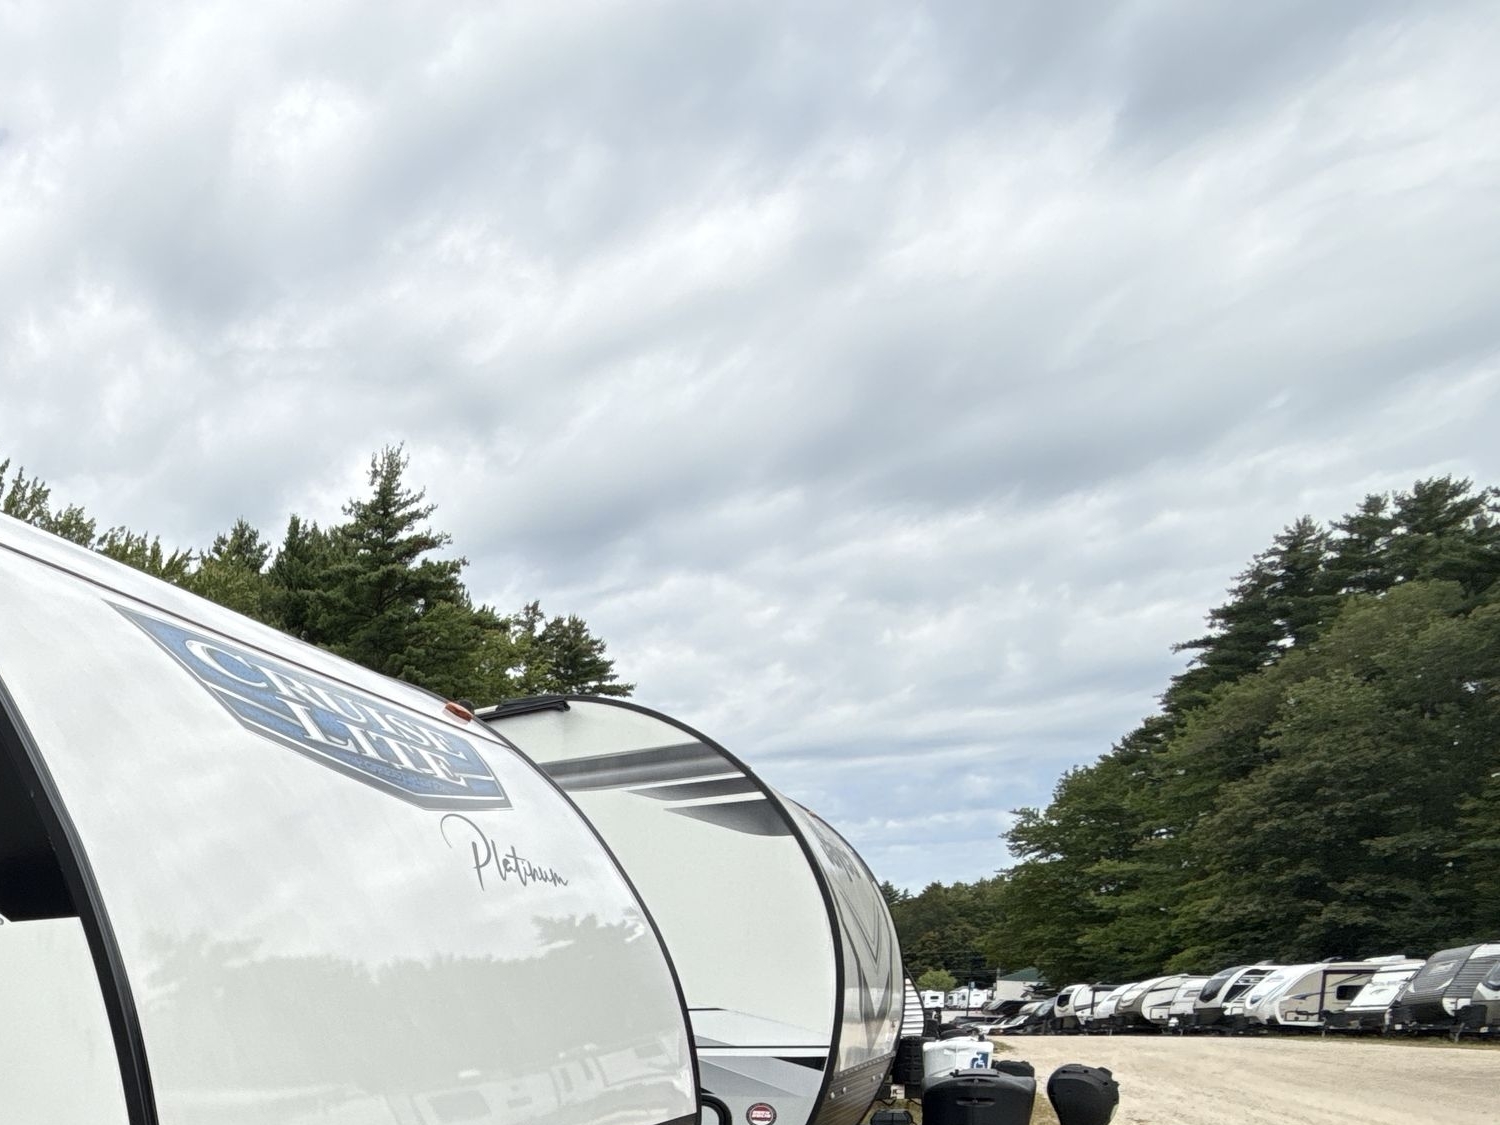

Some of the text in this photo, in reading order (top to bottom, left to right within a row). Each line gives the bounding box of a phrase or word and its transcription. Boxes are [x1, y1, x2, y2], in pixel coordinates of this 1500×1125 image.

[186, 640, 466, 760] CRUISE
[278, 696, 467, 787] LITE
[441, 814, 568, 892] Platinum
